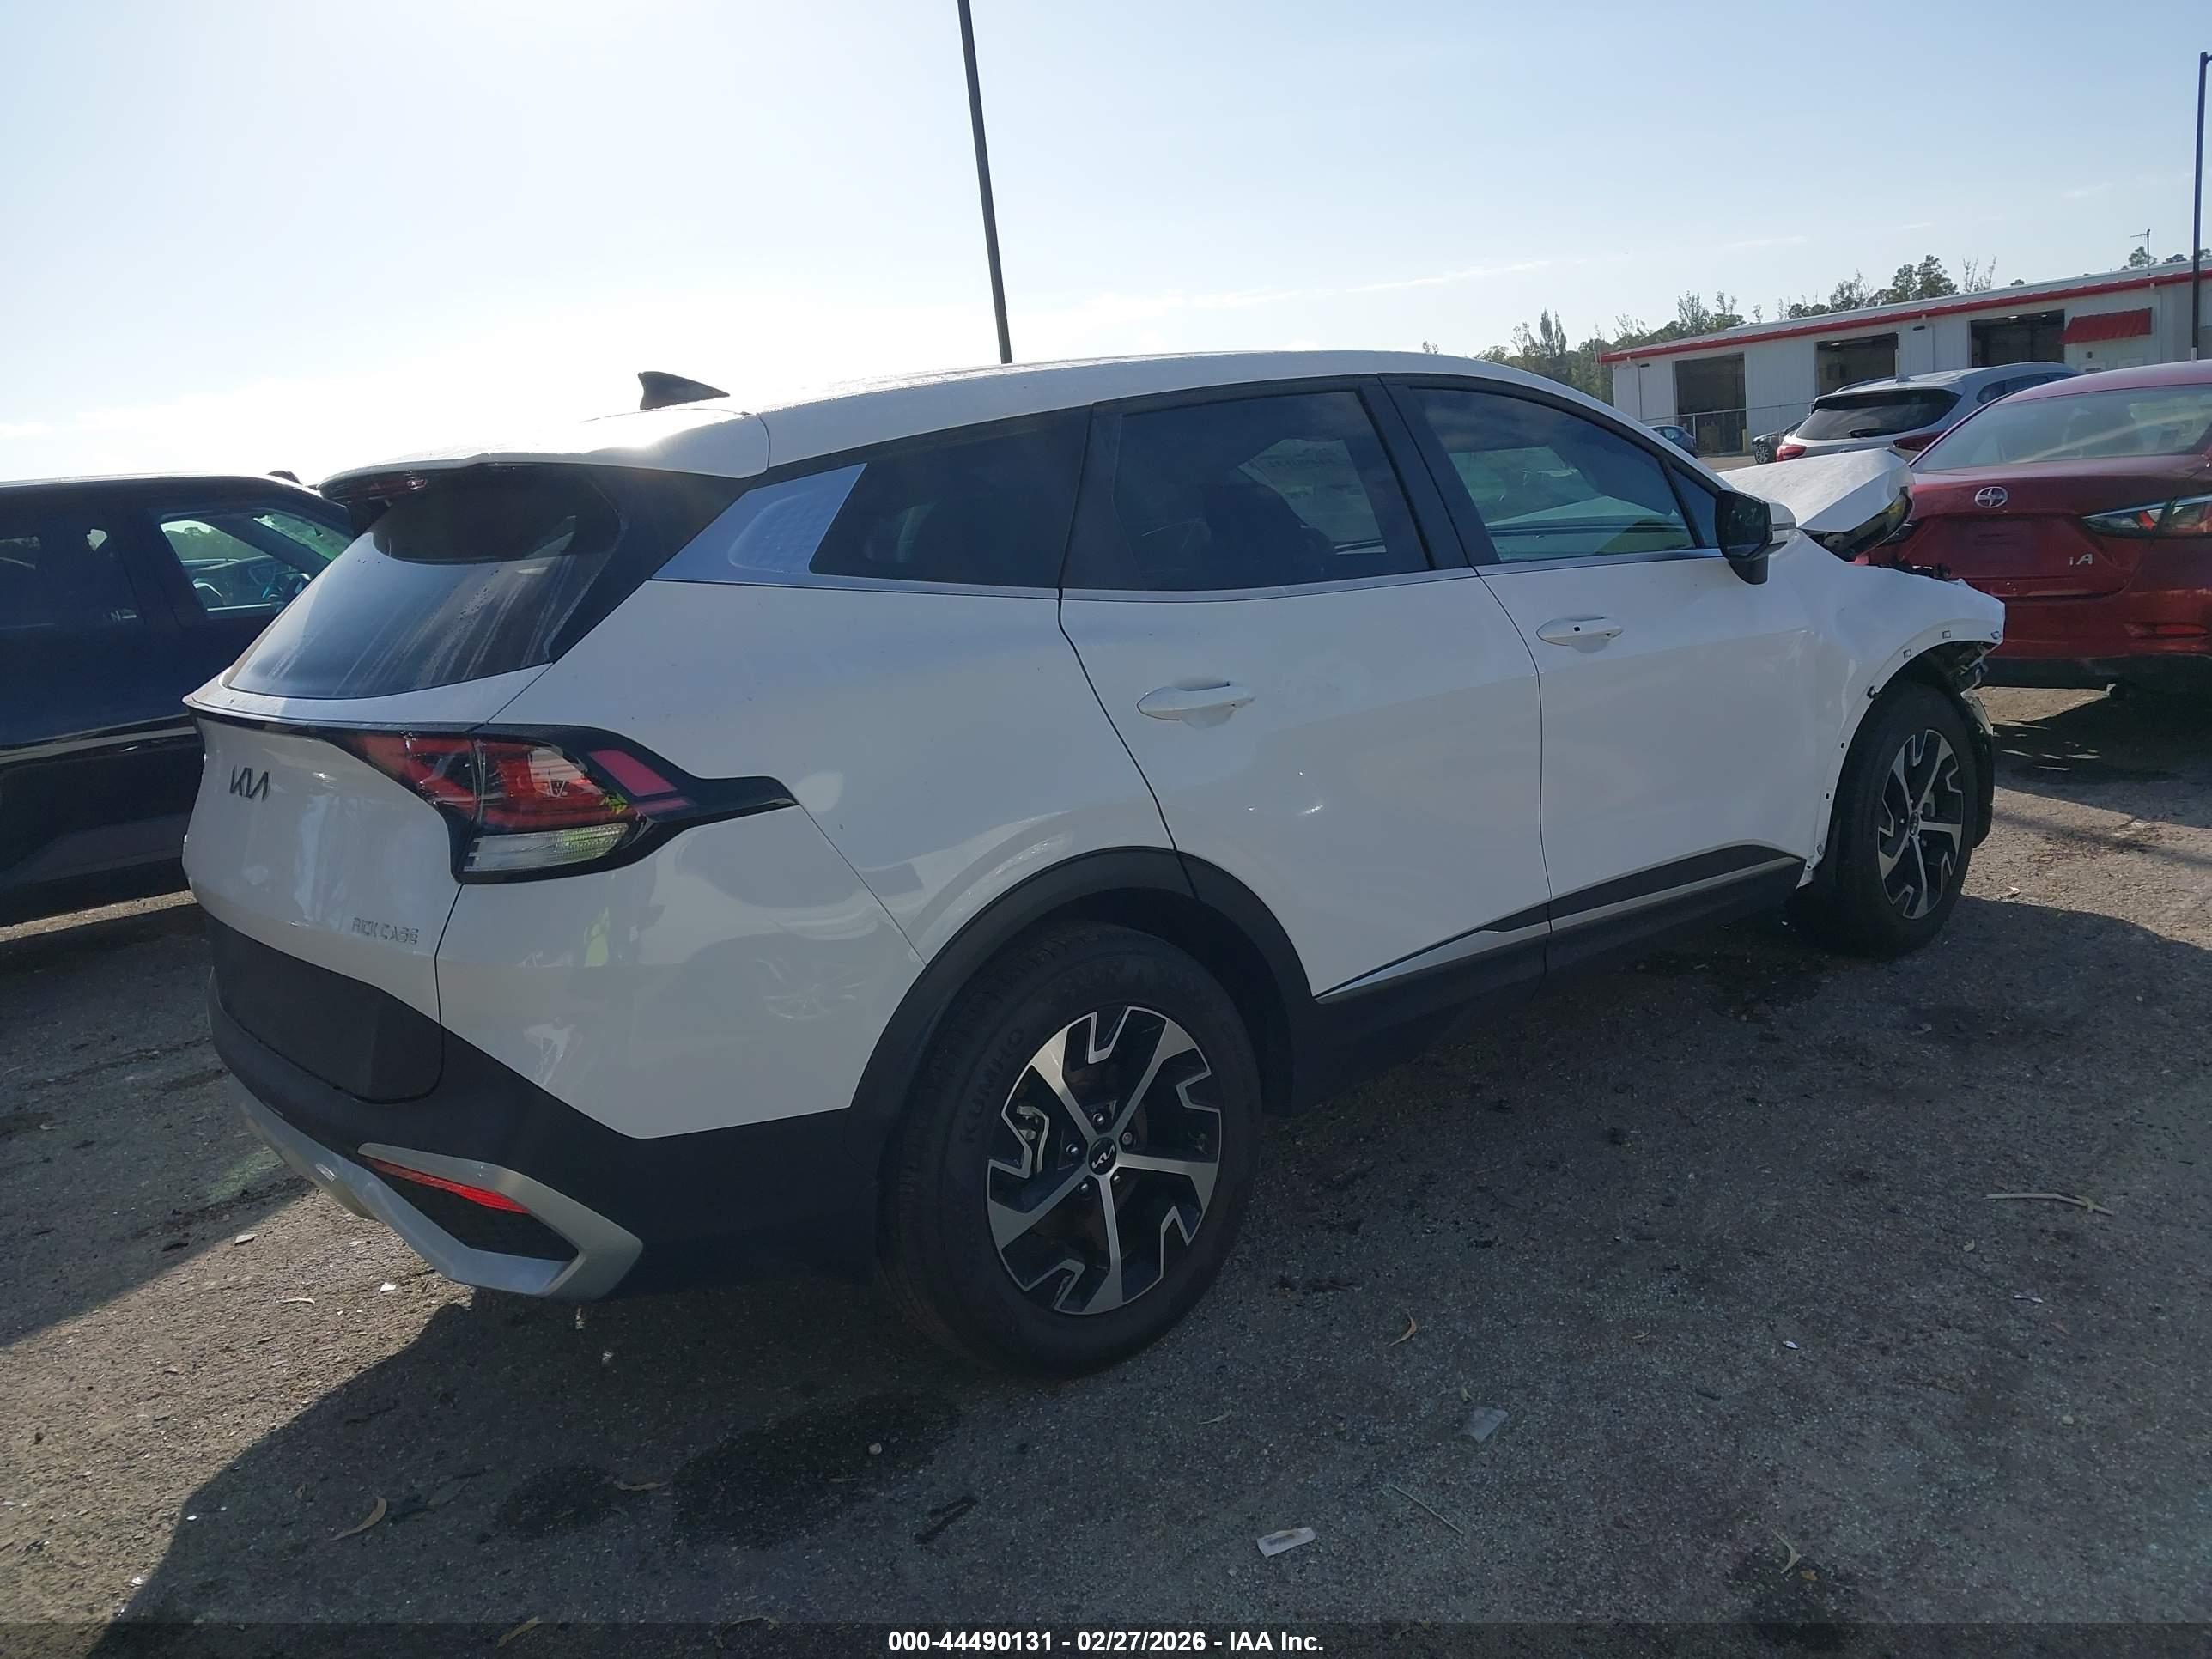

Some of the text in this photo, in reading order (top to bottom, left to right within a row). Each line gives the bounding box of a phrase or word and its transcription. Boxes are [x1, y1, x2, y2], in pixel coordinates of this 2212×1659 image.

[229, 763, 270, 803] KIA
[380, 922, 419, 945] CASE
[958, 1027, 1024, 1145] KUMHO
